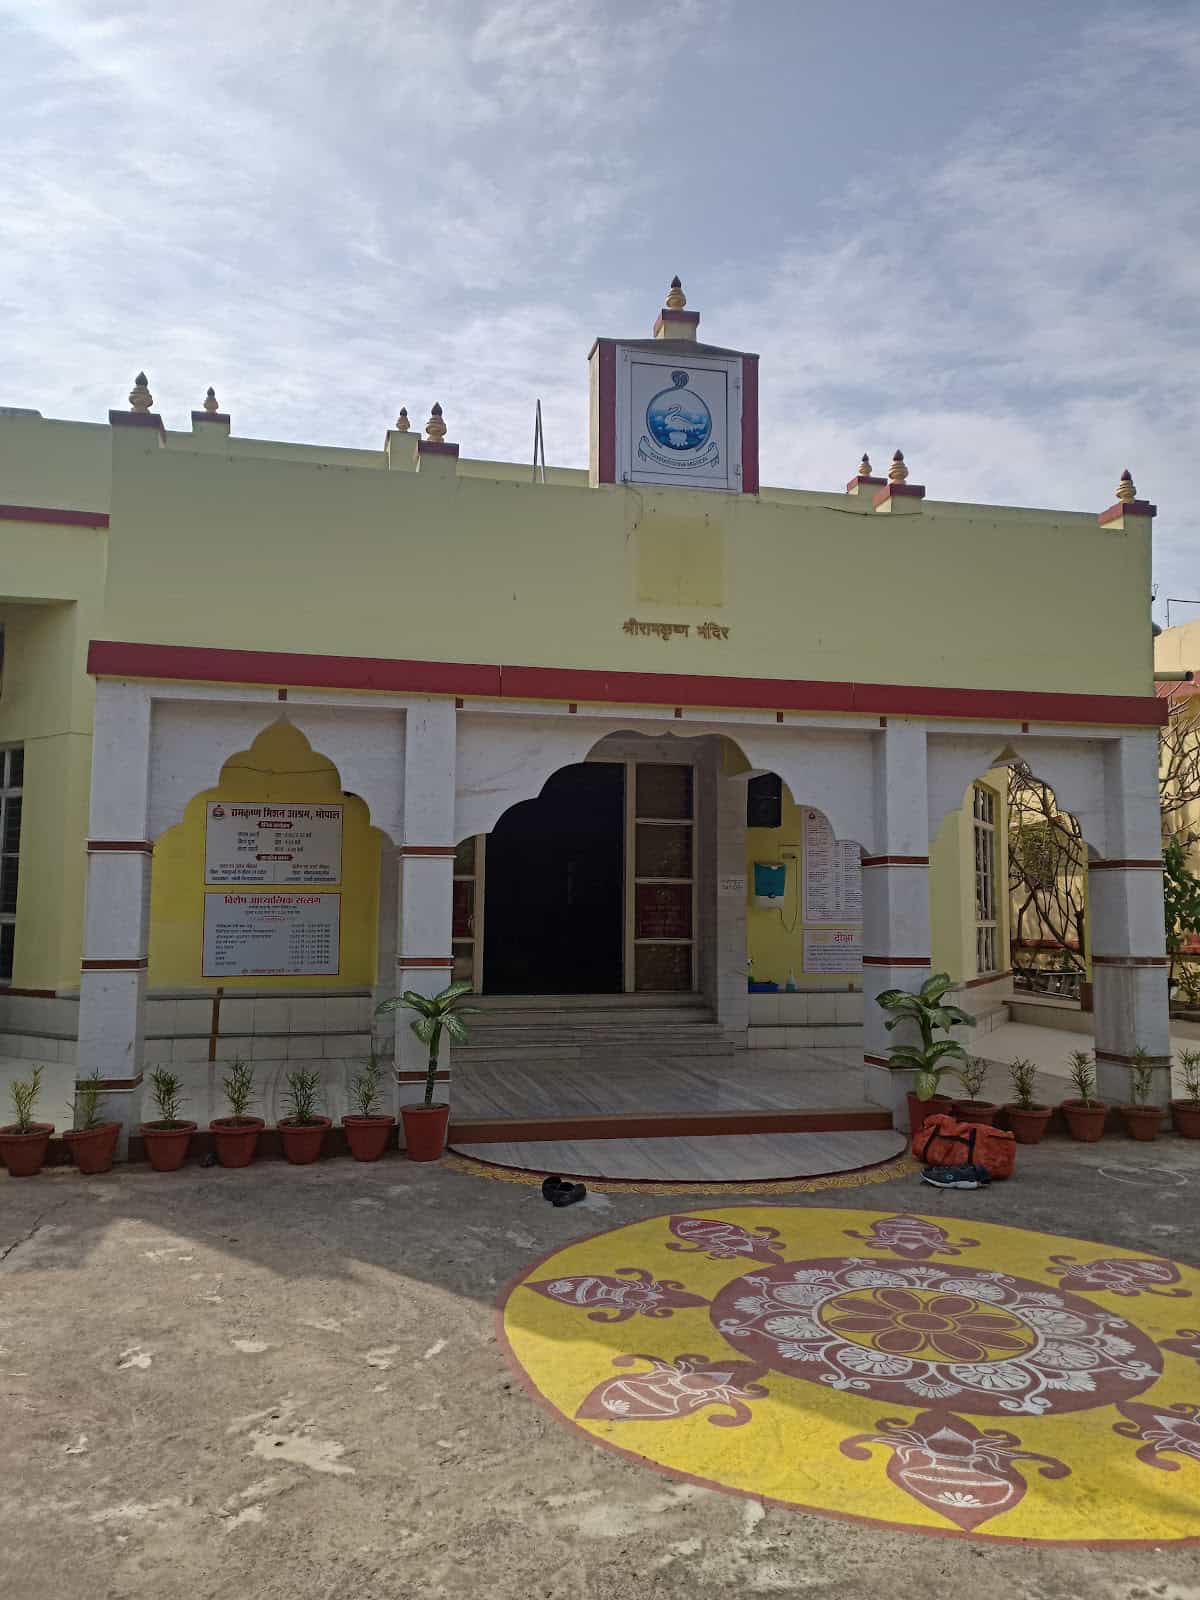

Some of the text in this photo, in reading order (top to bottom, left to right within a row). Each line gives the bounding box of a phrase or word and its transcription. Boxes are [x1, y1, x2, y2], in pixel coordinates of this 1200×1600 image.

[231, 807, 261, 820] रामकृष्ण
[263, 807, 285, 819] मिशन
[315, 808, 340, 820] भोपाल
